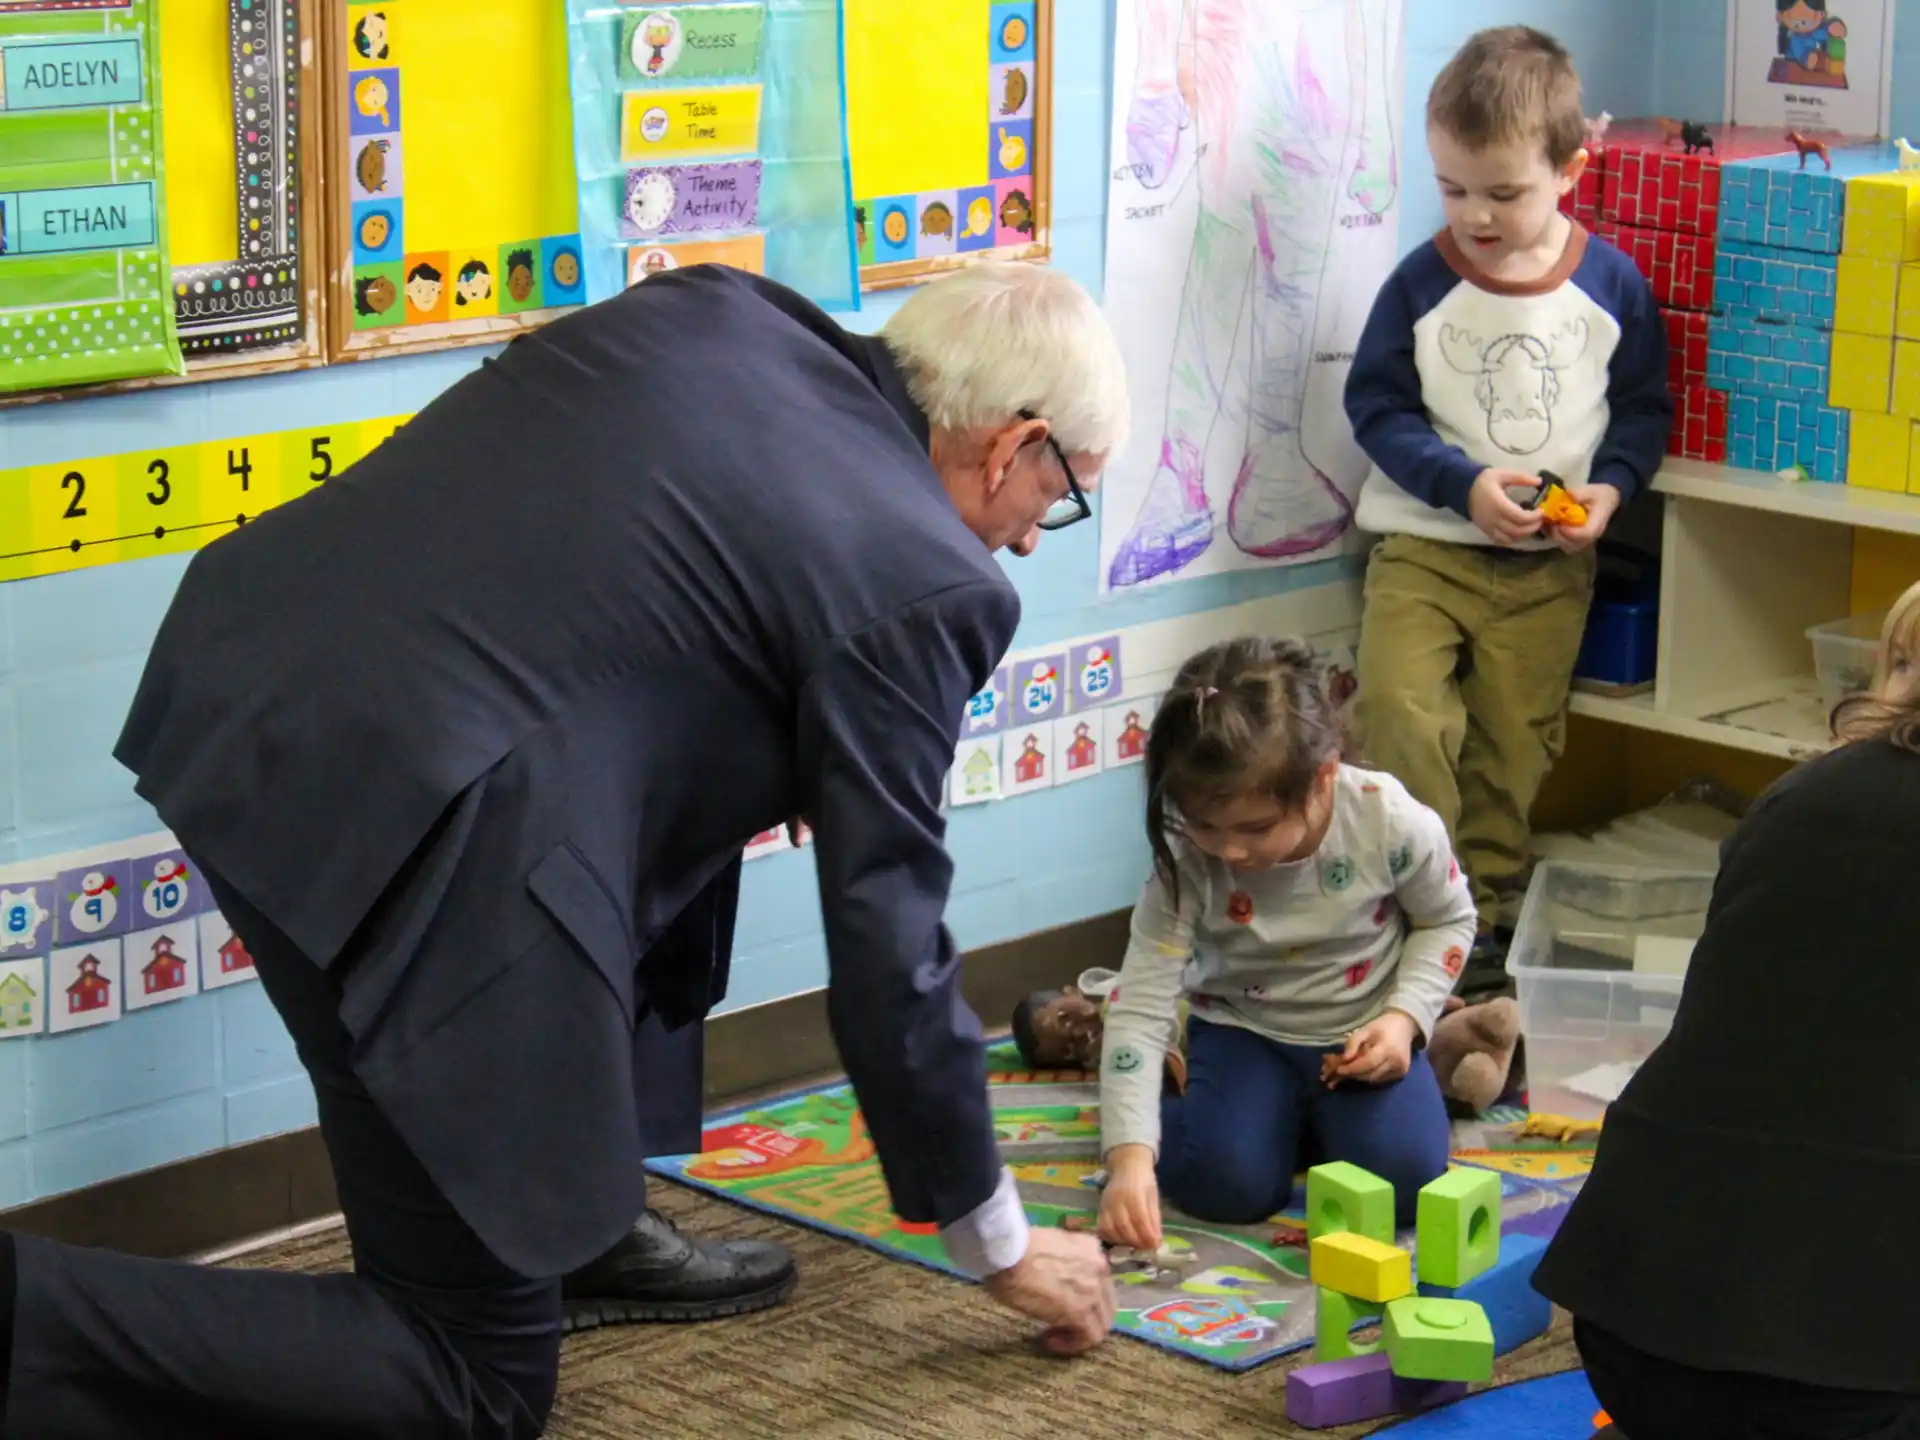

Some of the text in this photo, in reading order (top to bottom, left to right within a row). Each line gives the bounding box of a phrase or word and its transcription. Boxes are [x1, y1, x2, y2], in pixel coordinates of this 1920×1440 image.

[685, 29, 737, 49] Recess
[24, 59, 119, 89] ADELYN
[682, 101, 717, 117] Table
[685, 123, 716, 138] Time
[687, 175, 736, 192] Theme
[682, 195, 748, 217] Activity
[43, 206, 126, 235] ETHAN
[61, 437, 333, 519] 2 3 4 5
[970, 667, 1109, 717] 23 24 25
[8, 883, 180, 932] 8 9 10
